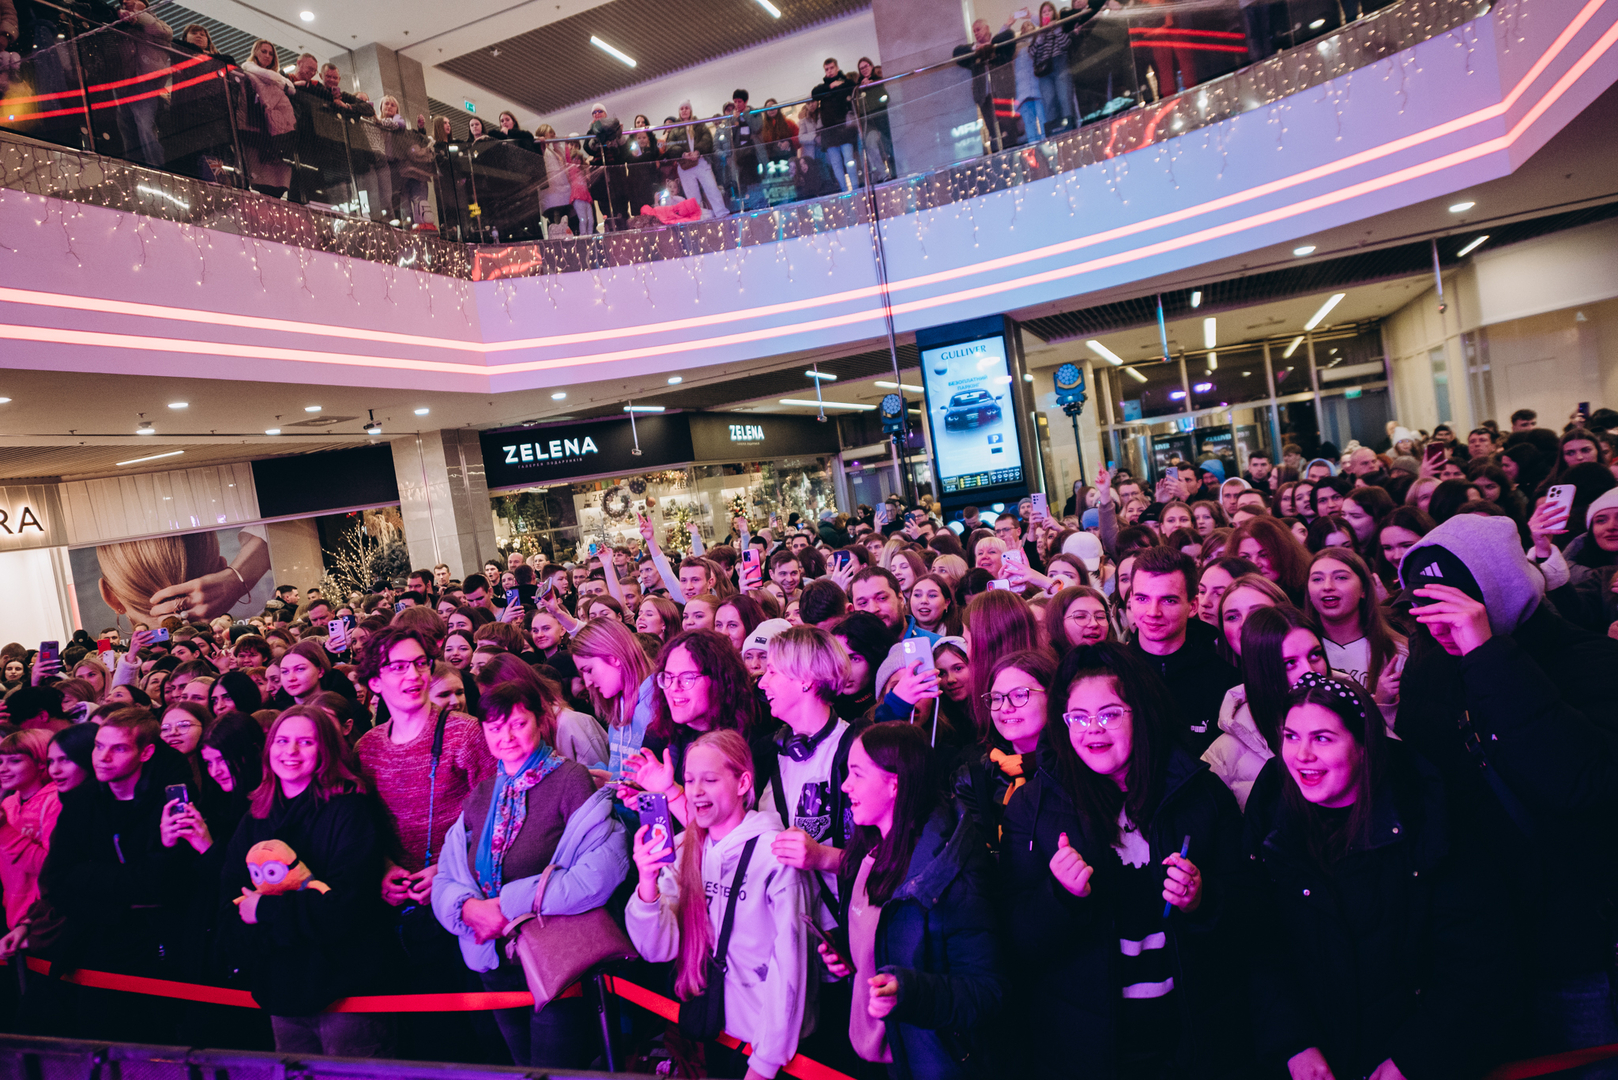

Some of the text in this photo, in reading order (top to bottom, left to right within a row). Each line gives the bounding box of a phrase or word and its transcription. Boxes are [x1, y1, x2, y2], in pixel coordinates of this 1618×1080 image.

[940, 344, 986, 360] GULLIVER
[728, 424, 765, 441] ZELENA
[502, 436, 598, 464] ZELENA
